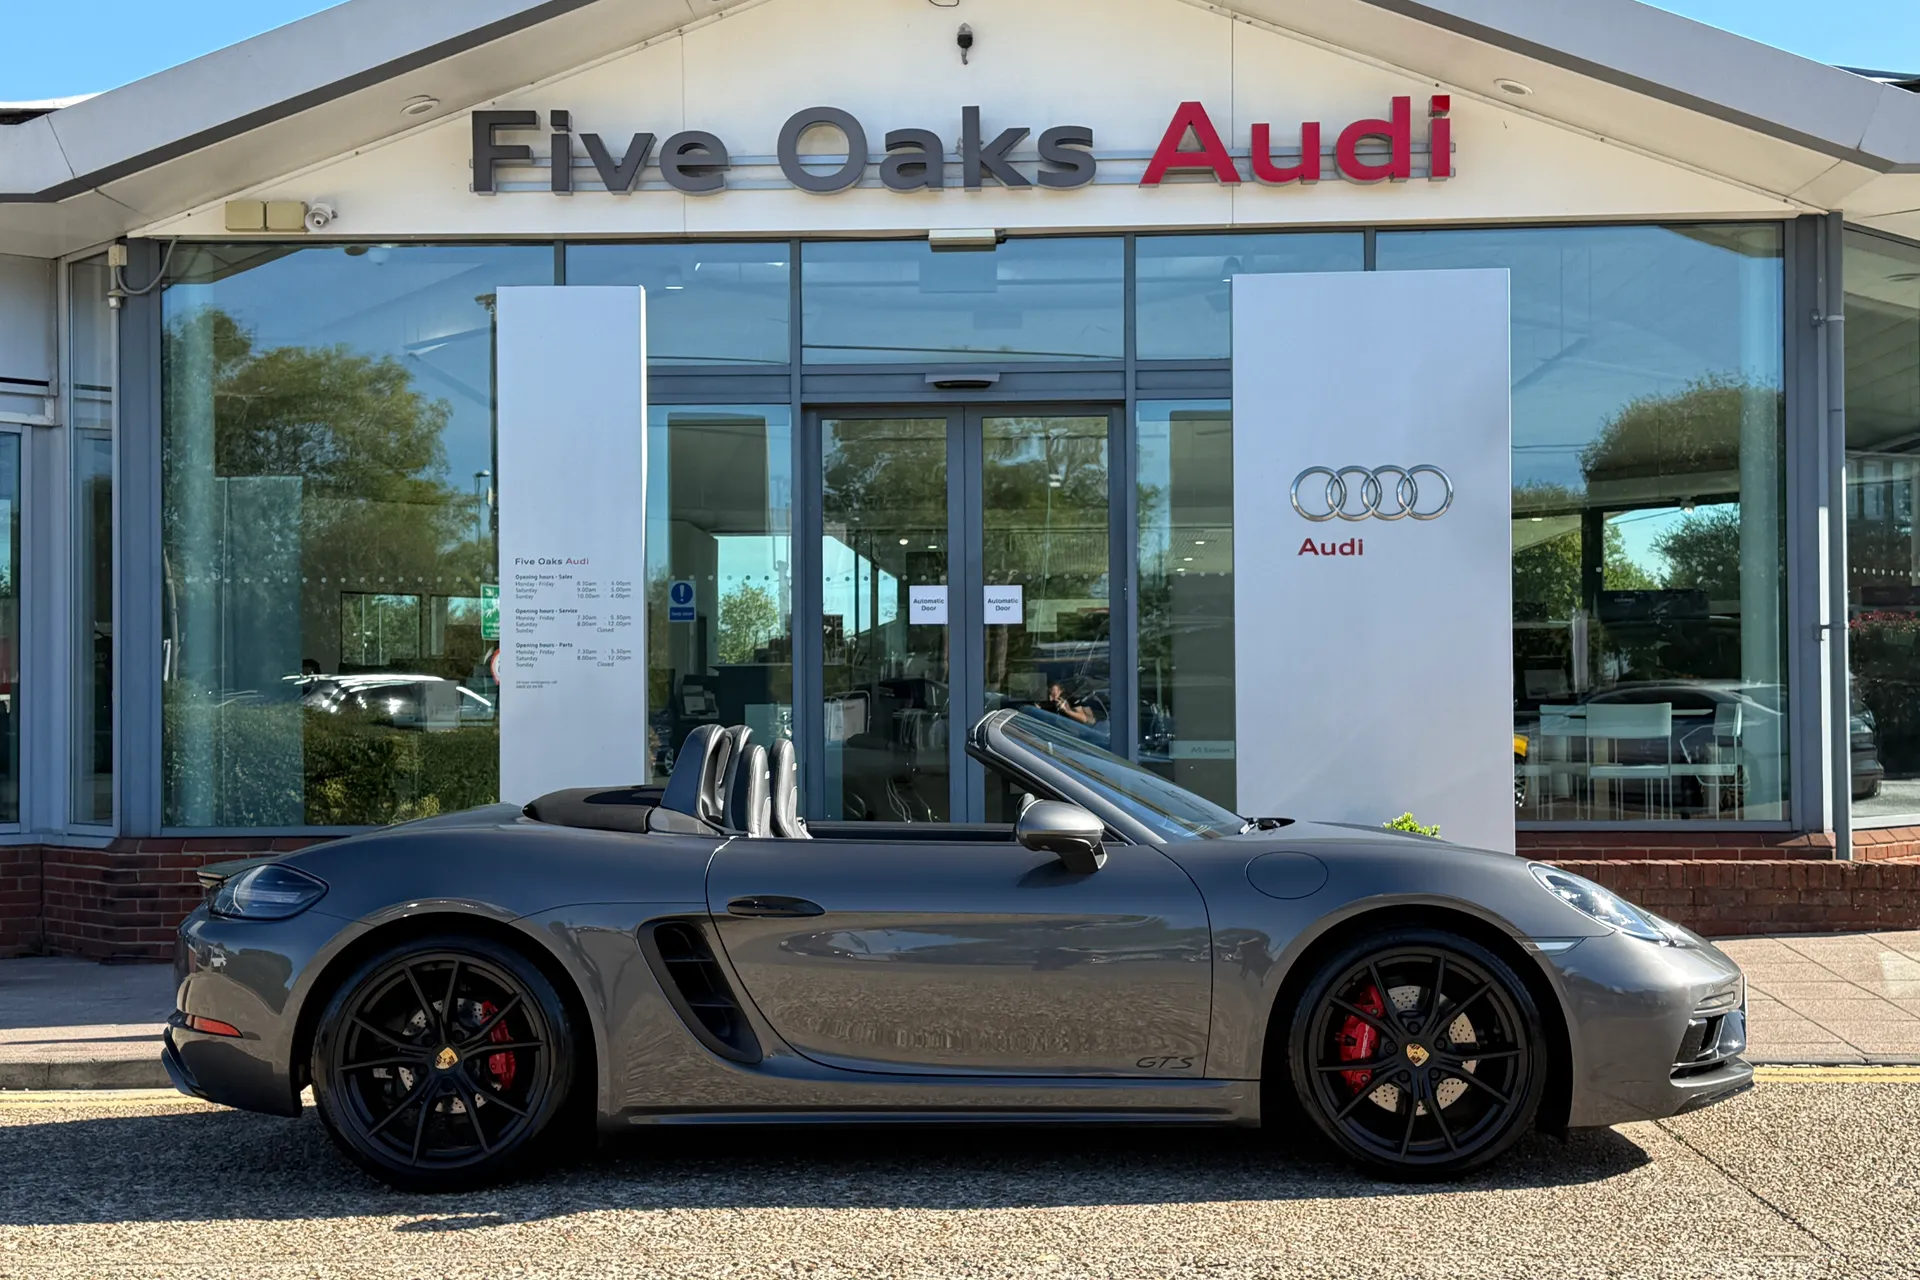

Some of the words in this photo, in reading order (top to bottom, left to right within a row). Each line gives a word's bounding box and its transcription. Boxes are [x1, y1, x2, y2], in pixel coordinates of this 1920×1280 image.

[472, 110, 731, 197] Five
[777, 106, 1096, 195] Oaks
[1138, 95, 1451, 187] Audi
[1298, 538, 1363, 556] Audi
[515, 558, 535, 566] Five
[538, 558, 562, 566] Oaks
[565, 558, 589, 566] Audi
[1136, 1056, 1194, 1069] GTS
